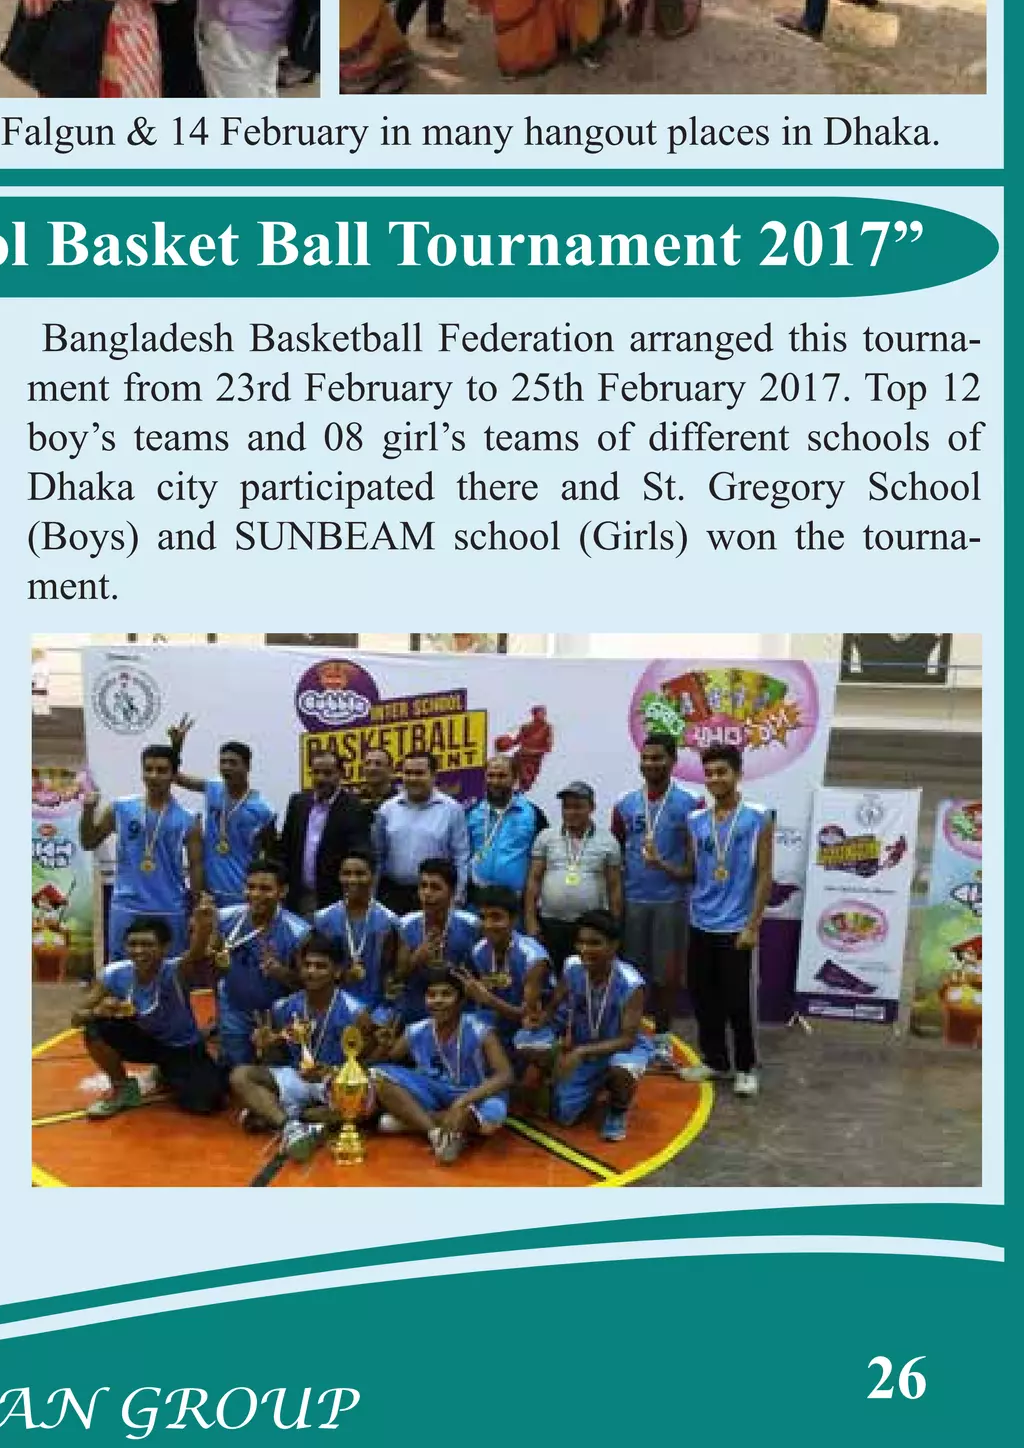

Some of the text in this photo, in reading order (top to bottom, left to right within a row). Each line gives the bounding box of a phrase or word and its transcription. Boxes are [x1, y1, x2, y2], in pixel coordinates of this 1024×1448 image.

[1, 115, 116, 155] Falgun
[127, 116, 158, 146] &
[173, 116, 209, 146] 14
[220, 115, 370, 155] February
[380, 115, 412, 146] in
[422, 125, 514, 155] many
[523, 115, 658, 155] hangout
[666, 115, 770, 155] places
[782, 115, 813, 146] in
[823, 115, 939, 146] Dhaka.
[46, 221, 240, 267] Basket
[256, 221, 371, 267] Ball
[388, 221, 742, 267] Tournament
[758, 220, 924, 268] 2017”
[42, 321, 981, 361] Bangladesh Basketball Federation arranged this tourna-
[27, 421, 987, 460] boy’s teams and 08 girl’s teams of different schools of
[28, 520, 981, 559] (Boys) and SUNBEAM school (Girls) won the tourna-
[866, 1355, 927, 1400] 26
[121, 1386, 361, 1440] GROUP
